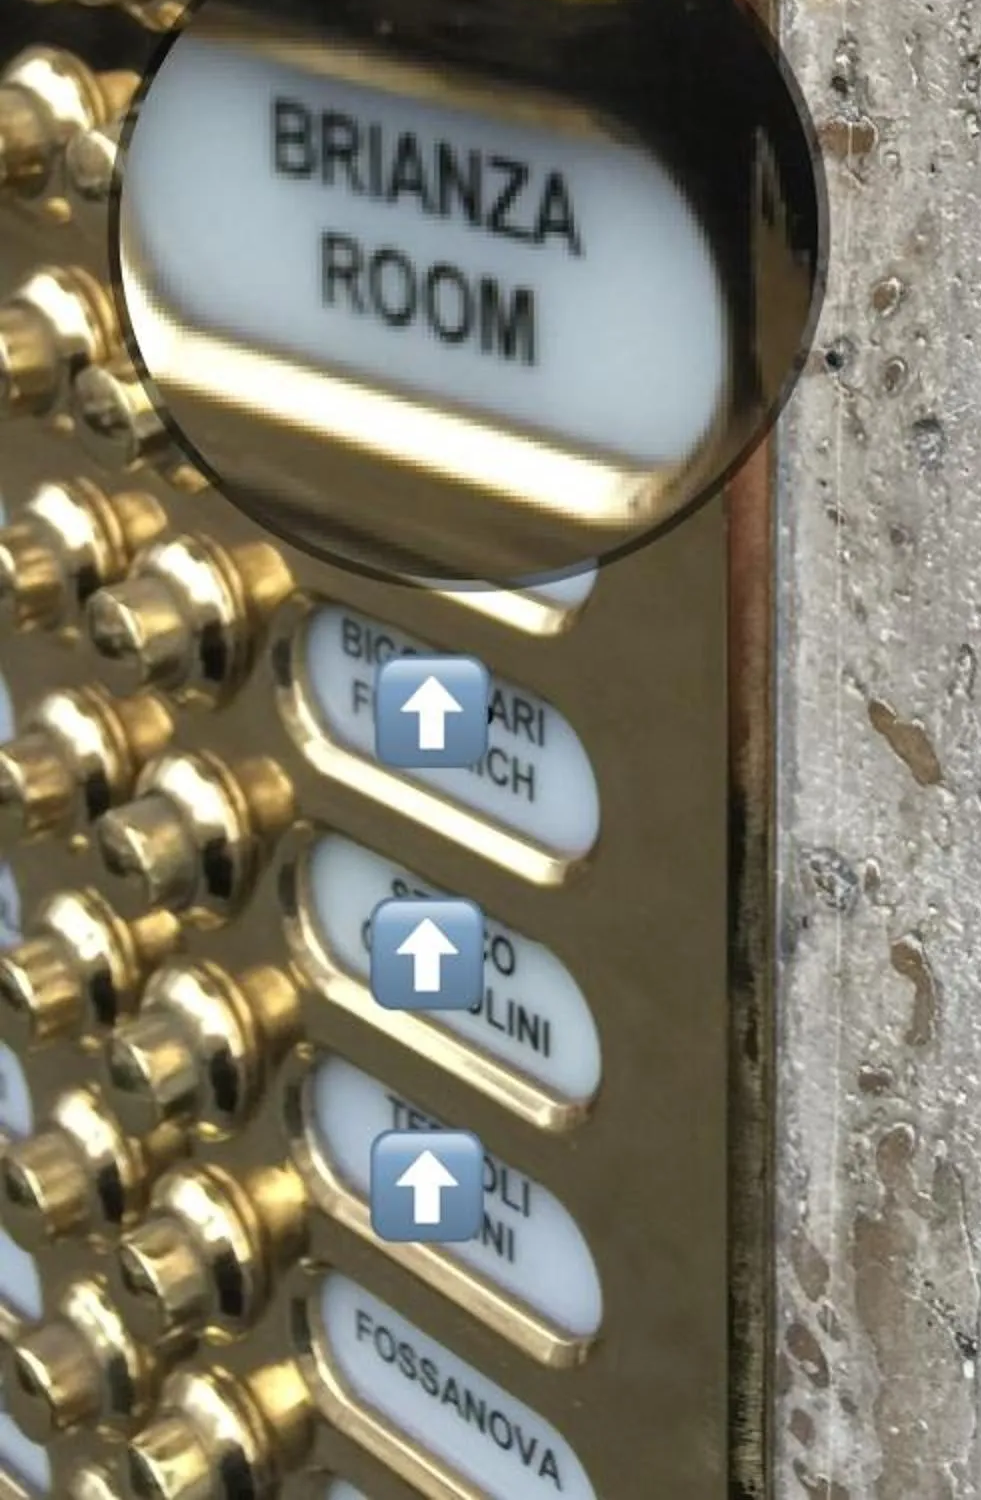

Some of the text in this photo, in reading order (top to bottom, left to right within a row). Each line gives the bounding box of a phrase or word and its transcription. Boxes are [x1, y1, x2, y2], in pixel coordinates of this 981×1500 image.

[272, 97, 584, 258] BRIANZA
[320, 230, 539, 367] ROOM
[355, 1308, 563, 1491] FOSSANOVA
